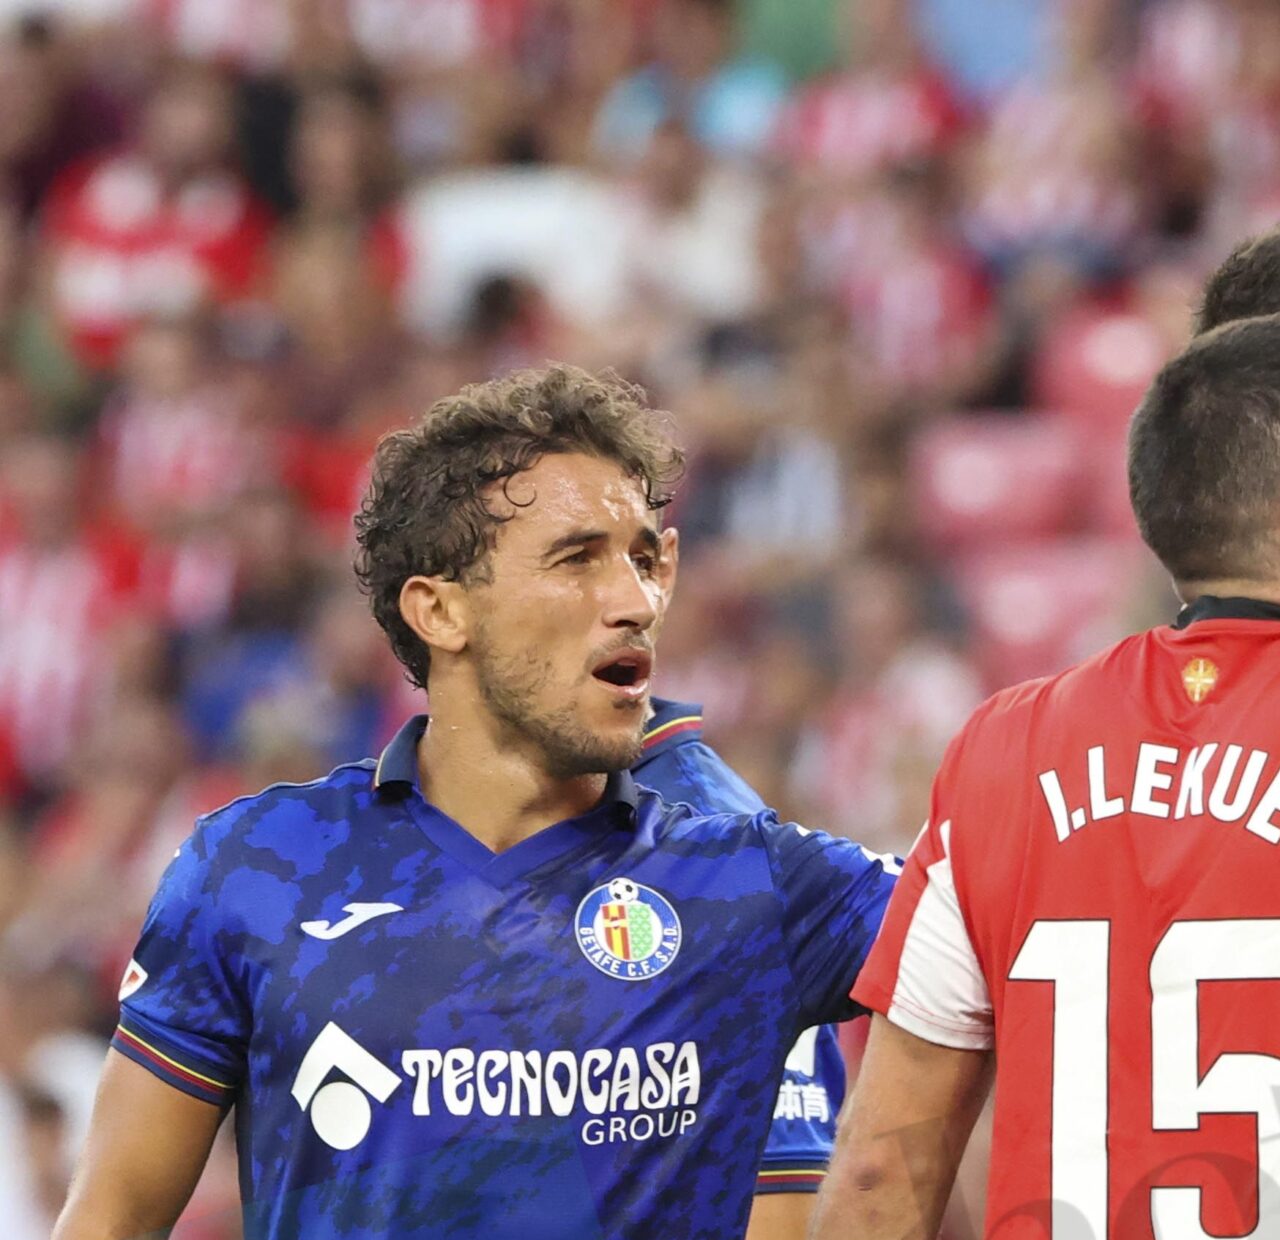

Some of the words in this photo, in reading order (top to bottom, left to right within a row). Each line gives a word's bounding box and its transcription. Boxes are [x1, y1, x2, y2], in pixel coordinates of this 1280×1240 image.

[580, 927, 621, 973] GETAFE
[402, 1042, 700, 1116] TECNOCASA
[581, 1109, 697, 1145] GROUP
